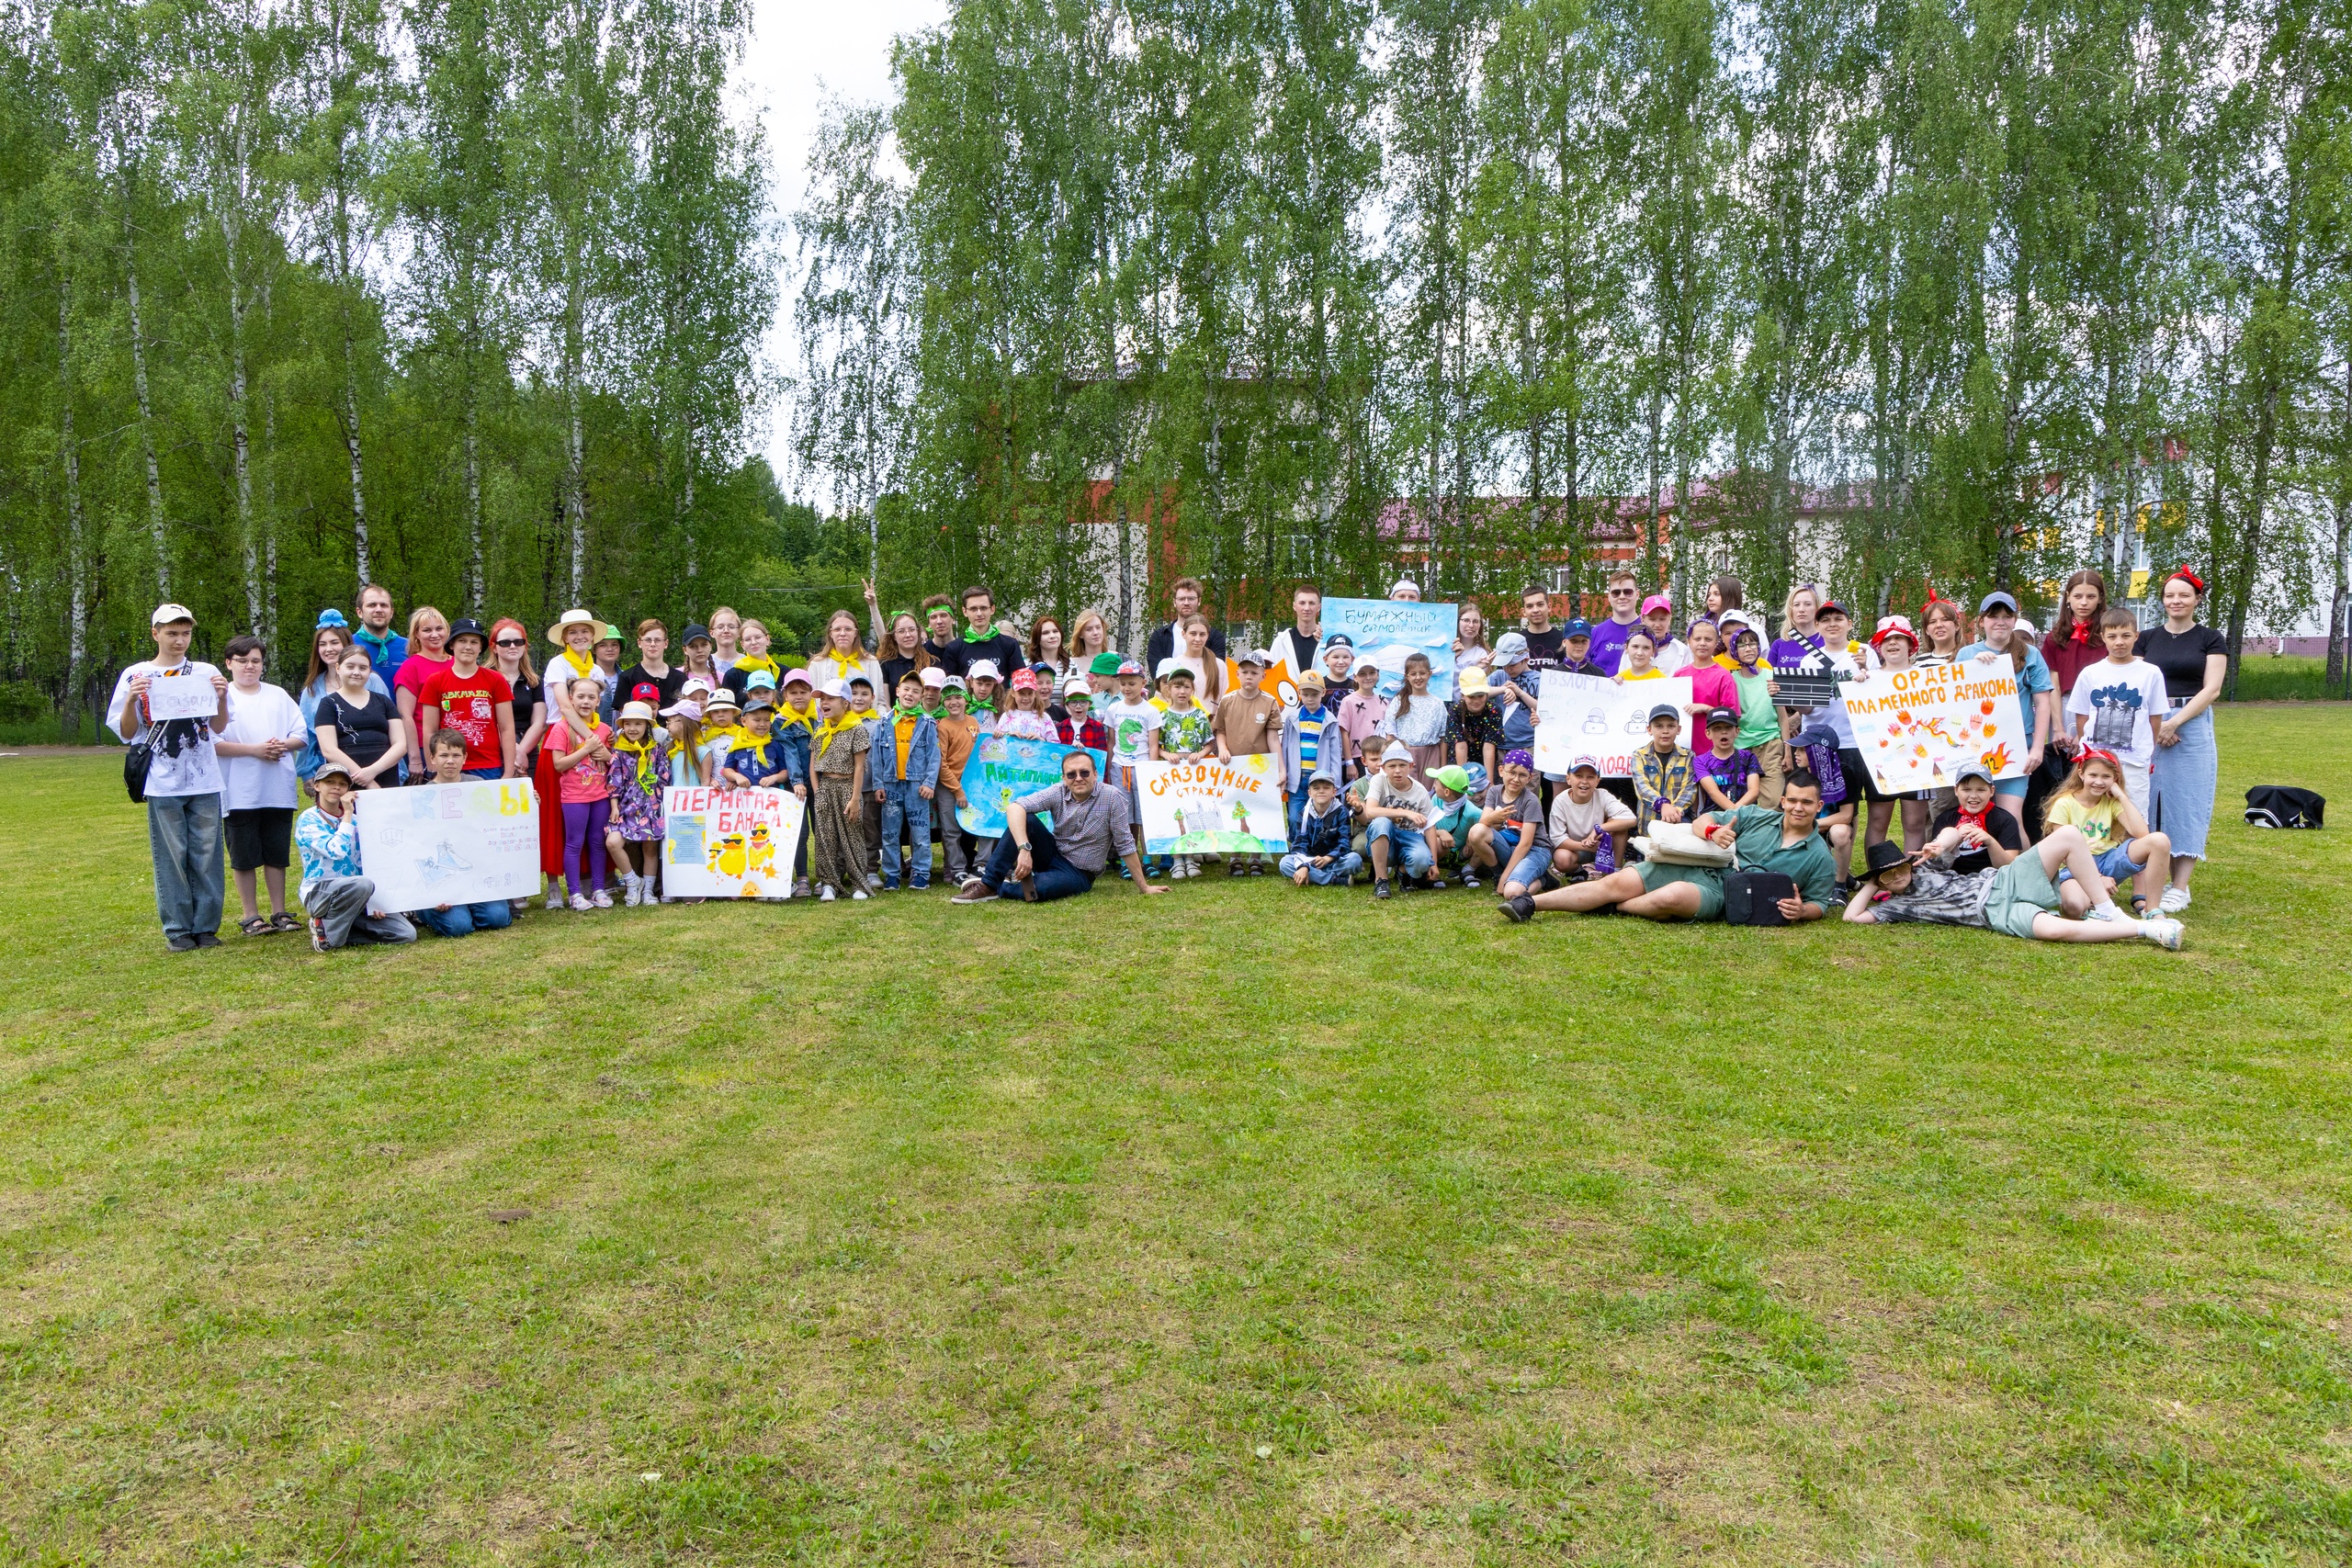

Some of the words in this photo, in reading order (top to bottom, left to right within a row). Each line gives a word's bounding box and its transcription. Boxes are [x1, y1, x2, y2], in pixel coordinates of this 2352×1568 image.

[1346, 609, 1437, 625] БУМАЖНЫЙ
[1893, 664, 1965, 691] ОРДЕН
[1847, 686, 1946, 714] ПЛАМЕННОГО
[1954, 678, 2018, 702] ДРАКОНА
[1984, 757, 1999, 770] 12
[1149, 765, 1262, 795] СКАЗОЧНЫЕ
[672, 788, 780, 812] ПЕРНАТАЯ
[1177, 785, 1224, 799] СТРАЖИ
[718, 811, 781, 832] БАНДА
